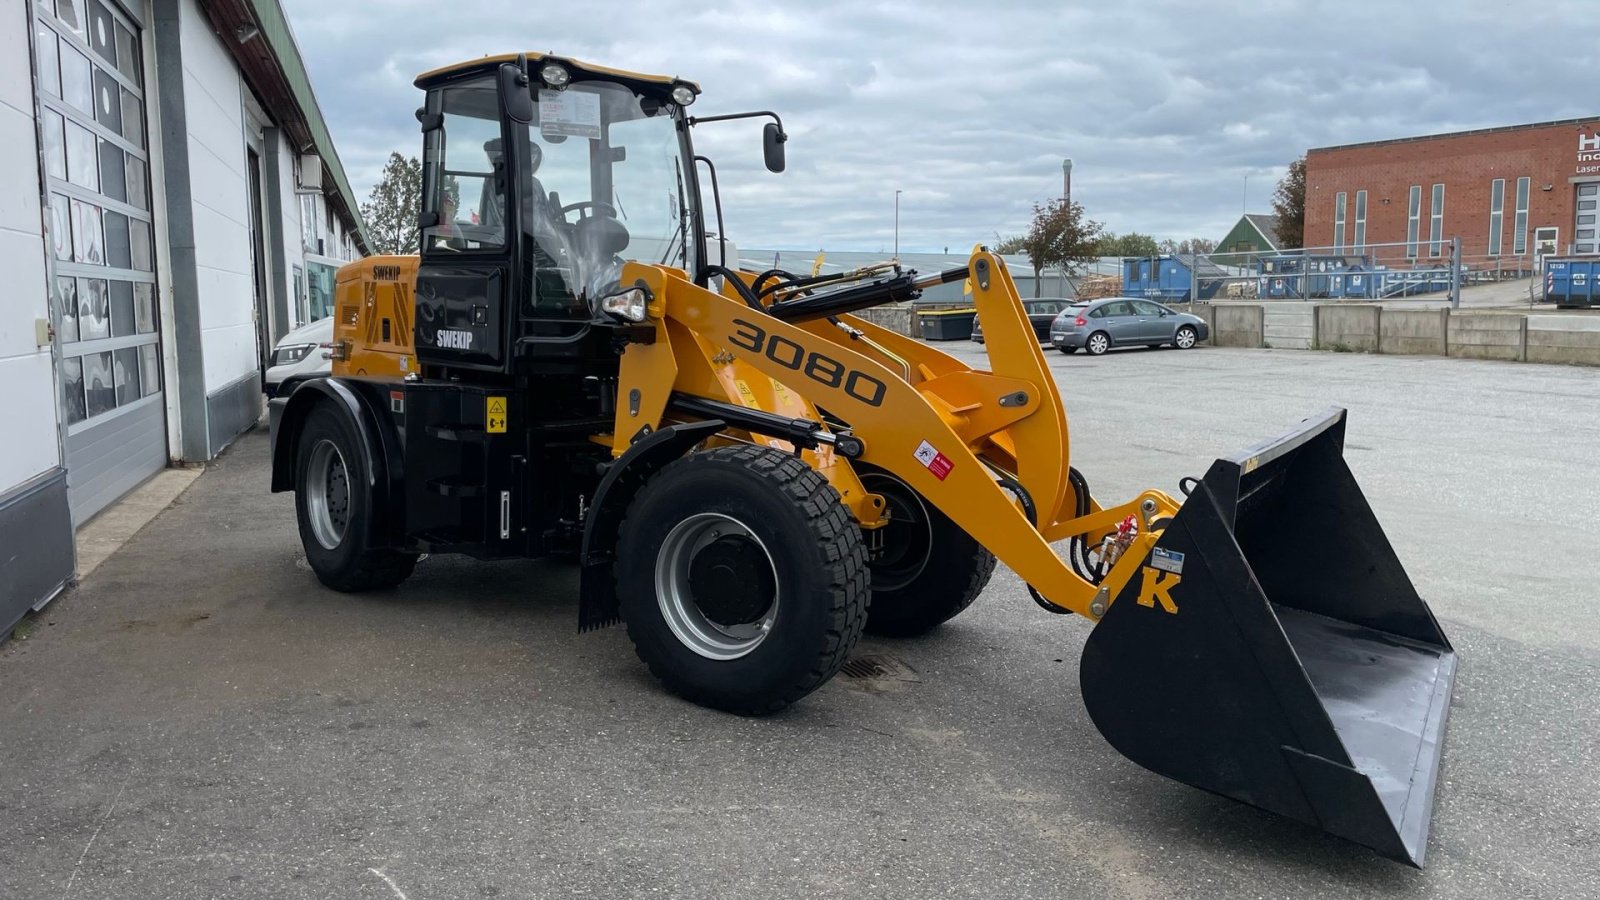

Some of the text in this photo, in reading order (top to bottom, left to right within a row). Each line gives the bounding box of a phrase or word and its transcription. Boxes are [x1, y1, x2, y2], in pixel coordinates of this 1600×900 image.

[373, 265, 401, 281] SWEKIP
[436, 329, 473, 350] SWEKIP
[728, 318, 887, 408] 3080
[1136, 566, 1182, 615] K
